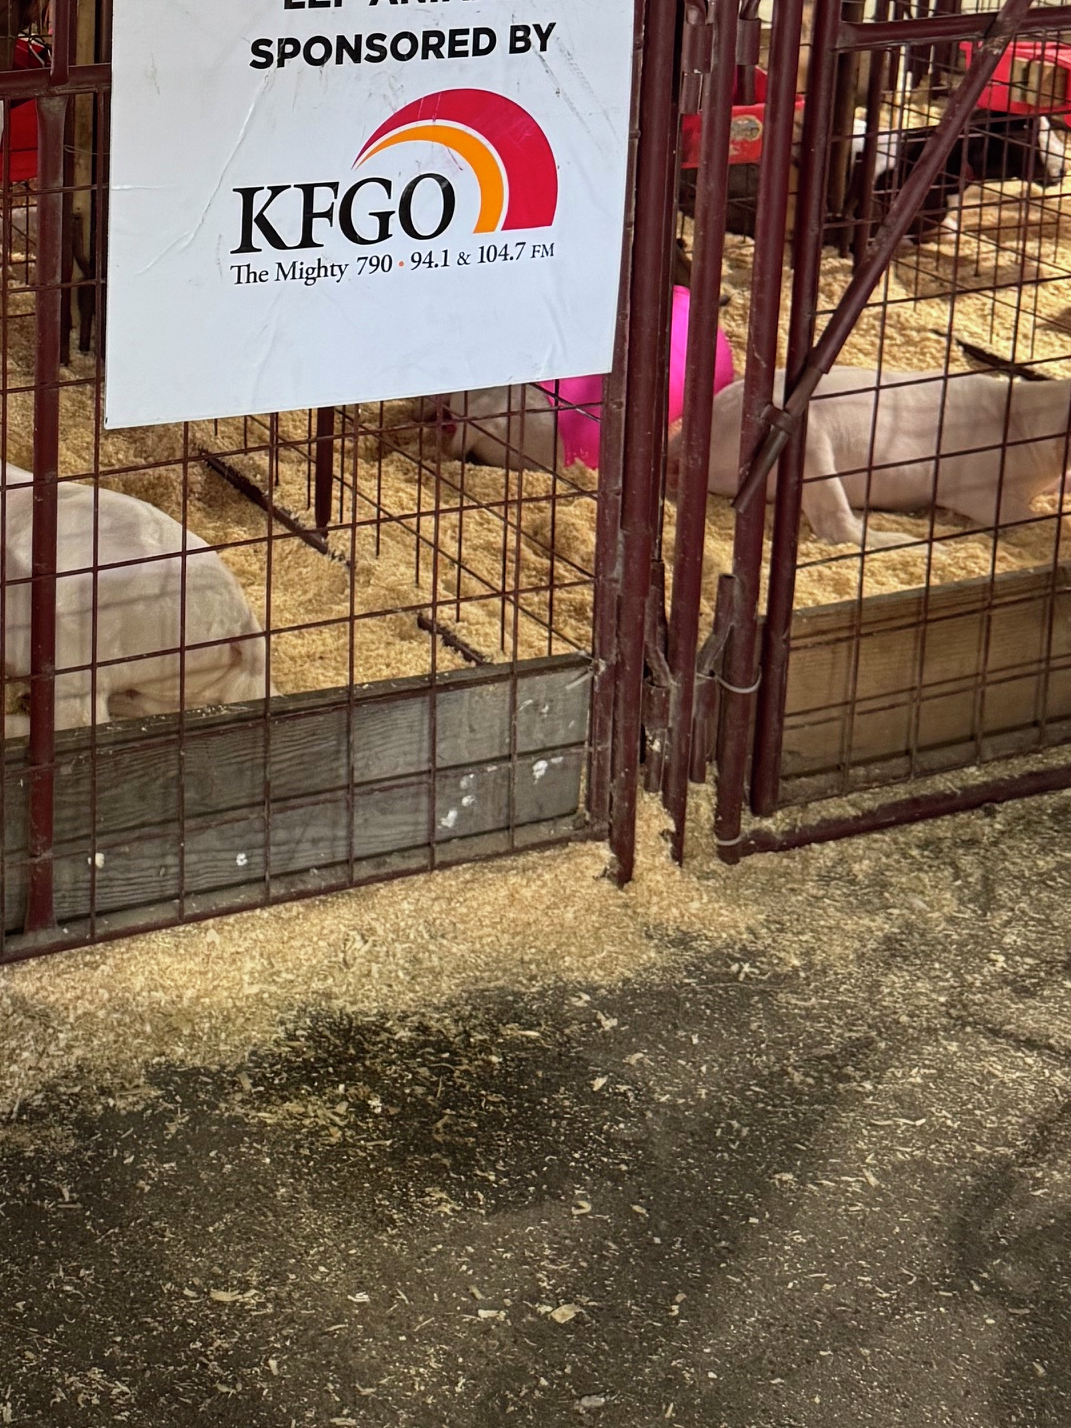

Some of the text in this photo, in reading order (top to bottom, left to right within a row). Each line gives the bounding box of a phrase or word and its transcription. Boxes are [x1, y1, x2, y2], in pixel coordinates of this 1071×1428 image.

[249, 22, 556, 70] SPONSORED BY
[230, 172, 456, 254] KFGO
[230, 241, 555, 286] The Mighty 790 94.1 & 104.7 FM
